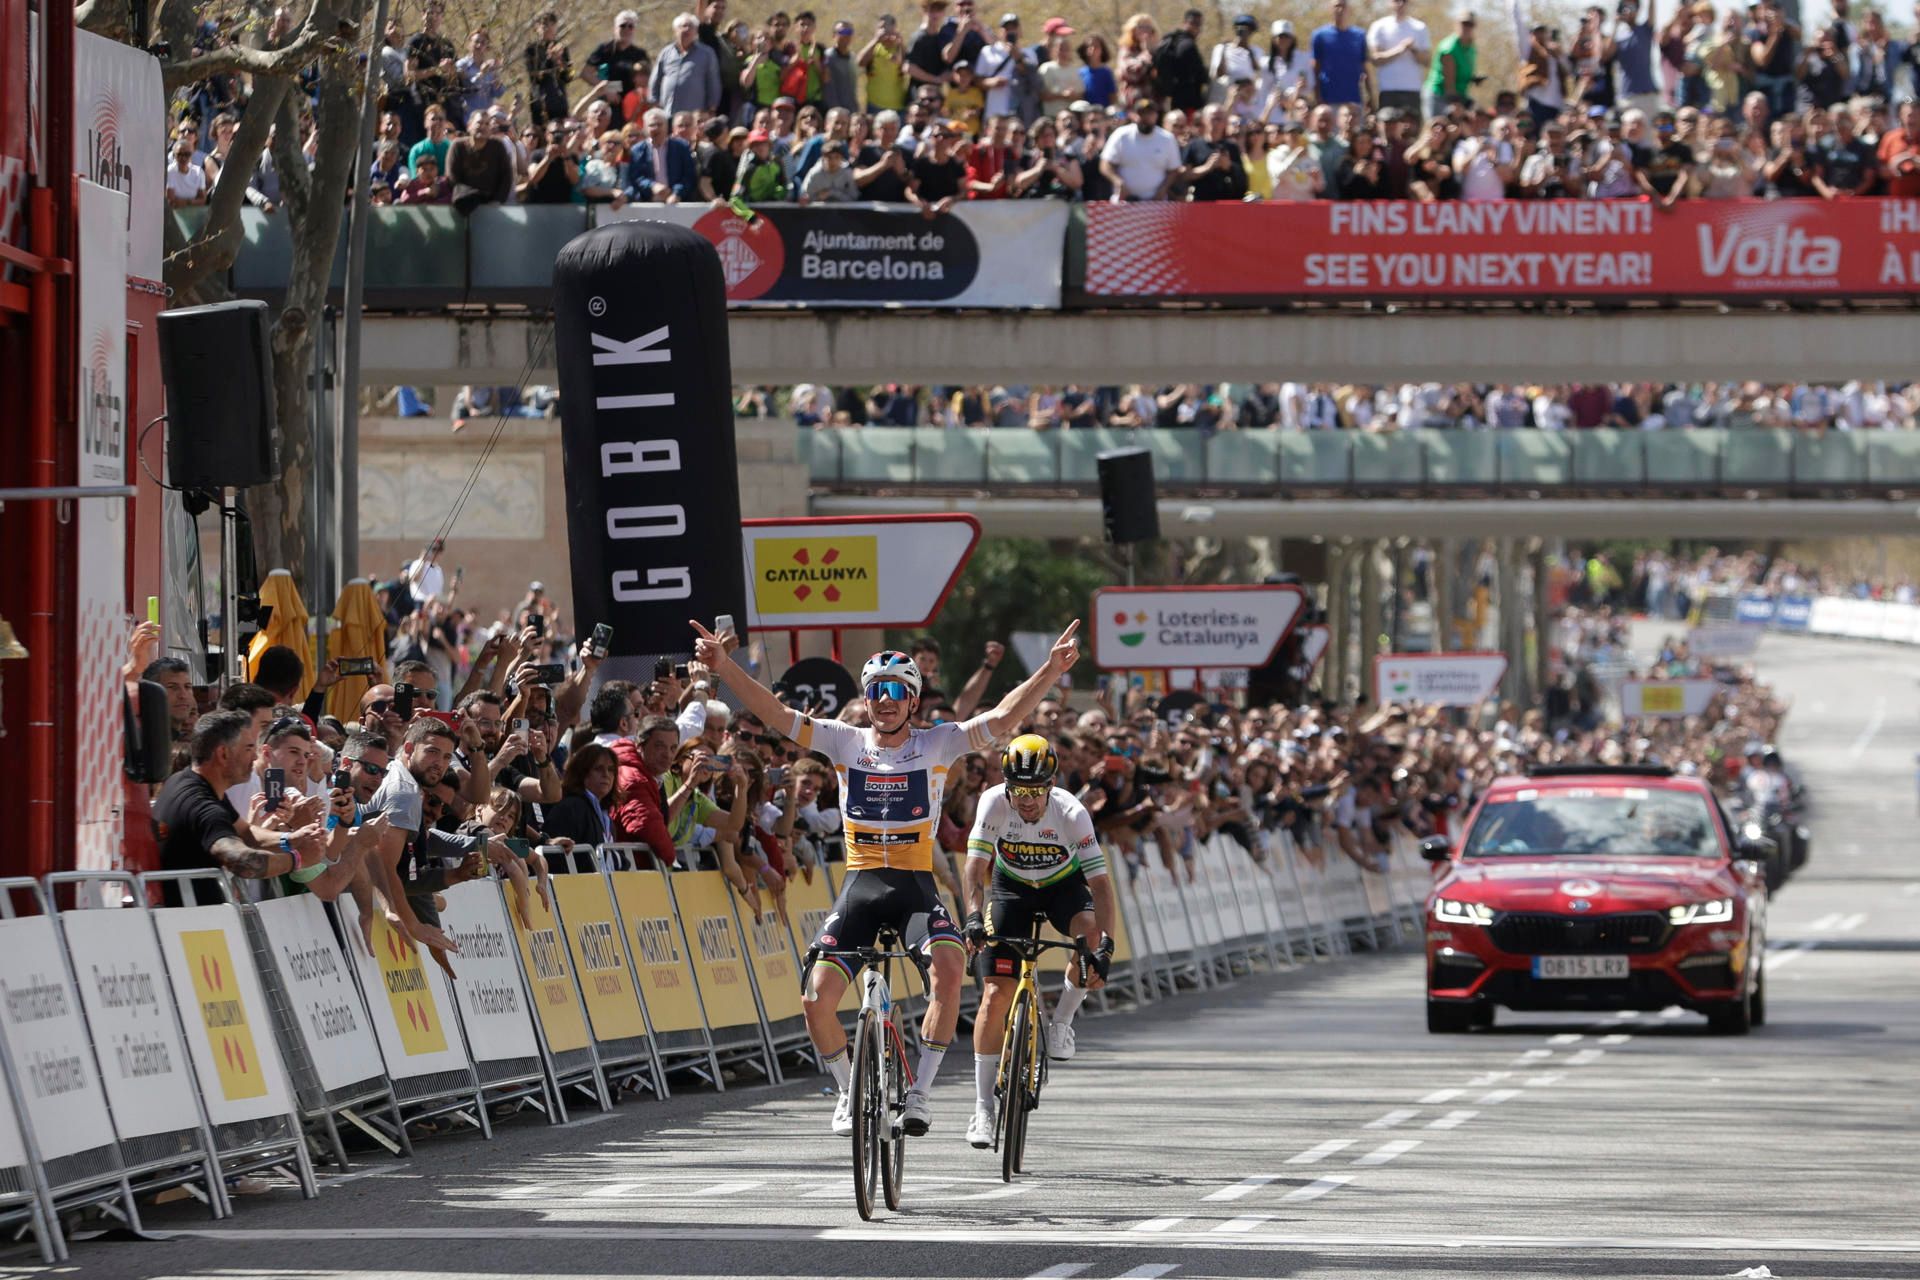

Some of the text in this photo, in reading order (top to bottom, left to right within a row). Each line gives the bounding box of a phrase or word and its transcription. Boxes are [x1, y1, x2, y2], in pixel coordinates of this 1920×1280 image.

[1330, 203, 1653, 235] FINS L'ANY VINENT!
[803, 230, 944, 252] Ajuntament de
[1697, 213, 1842, 277] Volta
[801, 254, 944, 279] Barcelona
[1304, 253, 1653, 286] SEE YOU NEXT YEAR!
[591, 325, 692, 602] GOBIK
[765, 567, 868, 582] CATALUNYA
[1157, 609, 1258, 627] Loteries de
[1157, 629, 1259, 649] Catalunya
[269, 781, 281, 798] R
[865, 782, 908, 791] SOUDAL
[1002, 843, 1061, 854] JUMBO
[576, 920, 621, 972] MORITZ
[633, 915, 680, 966] MORITZ
[695, 914, 737, 964] MORITZ
[1544, 956, 1626, 976] 0815 LRX
[386, 967, 427, 994] CATALUNYA
